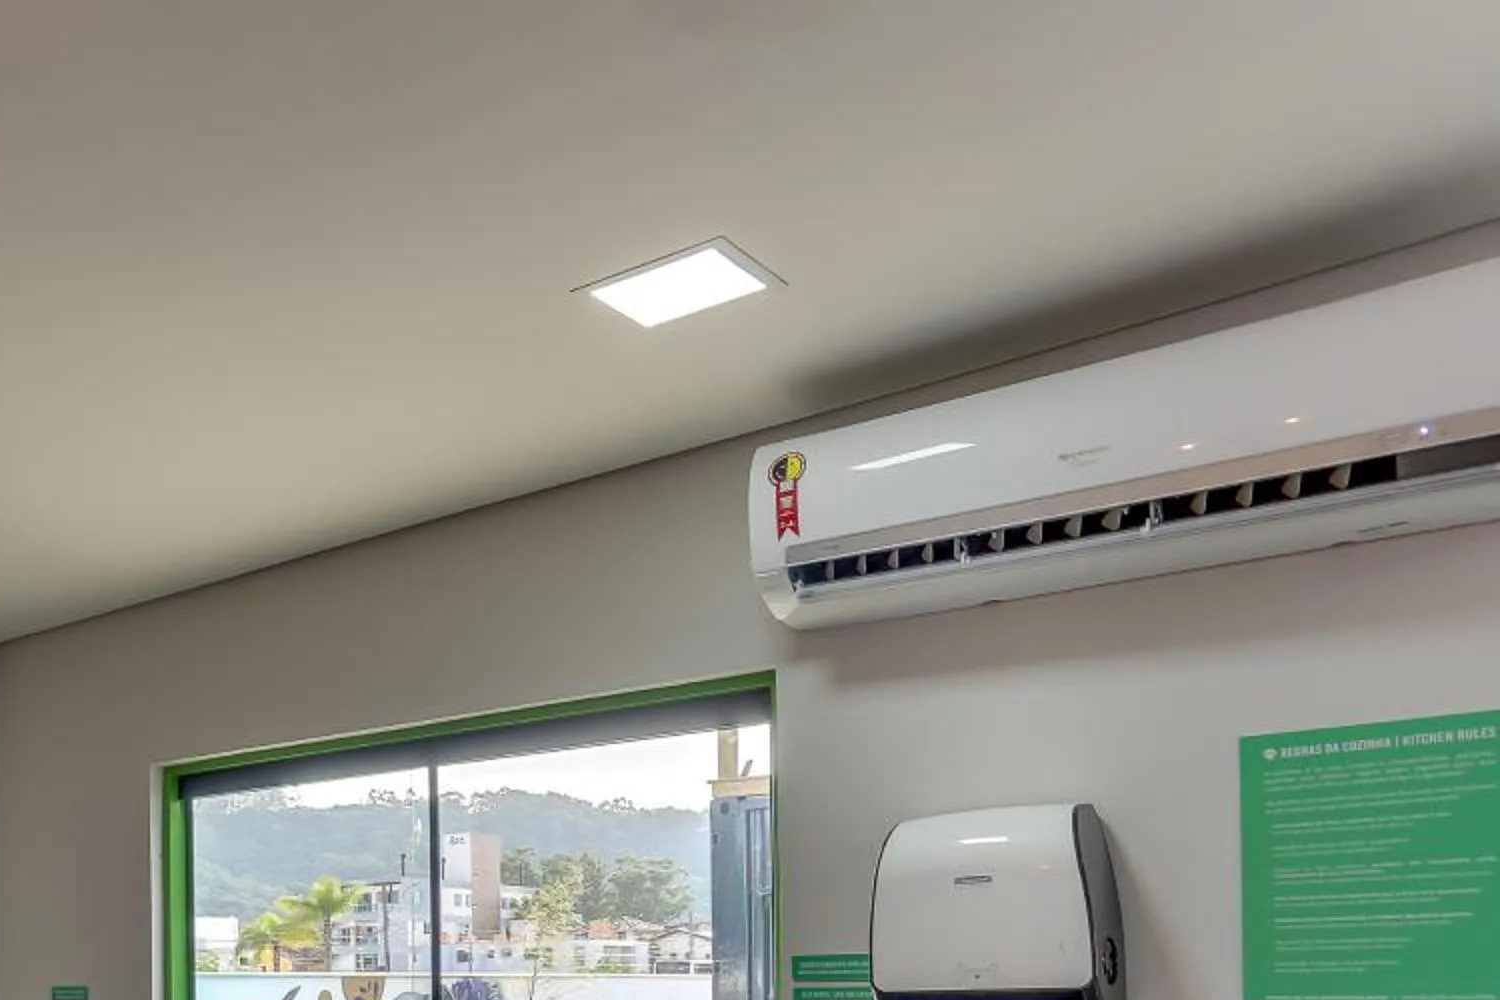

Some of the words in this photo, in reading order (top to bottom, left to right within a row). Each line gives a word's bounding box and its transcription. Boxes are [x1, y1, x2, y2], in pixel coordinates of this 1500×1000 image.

[1325, 740, 1339, 754] DA
[1342, 736, 1391, 753] COZINHA
[1403, 730, 1454, 749] KITCHEN
[1457, 726, 1496, 742] RULES
